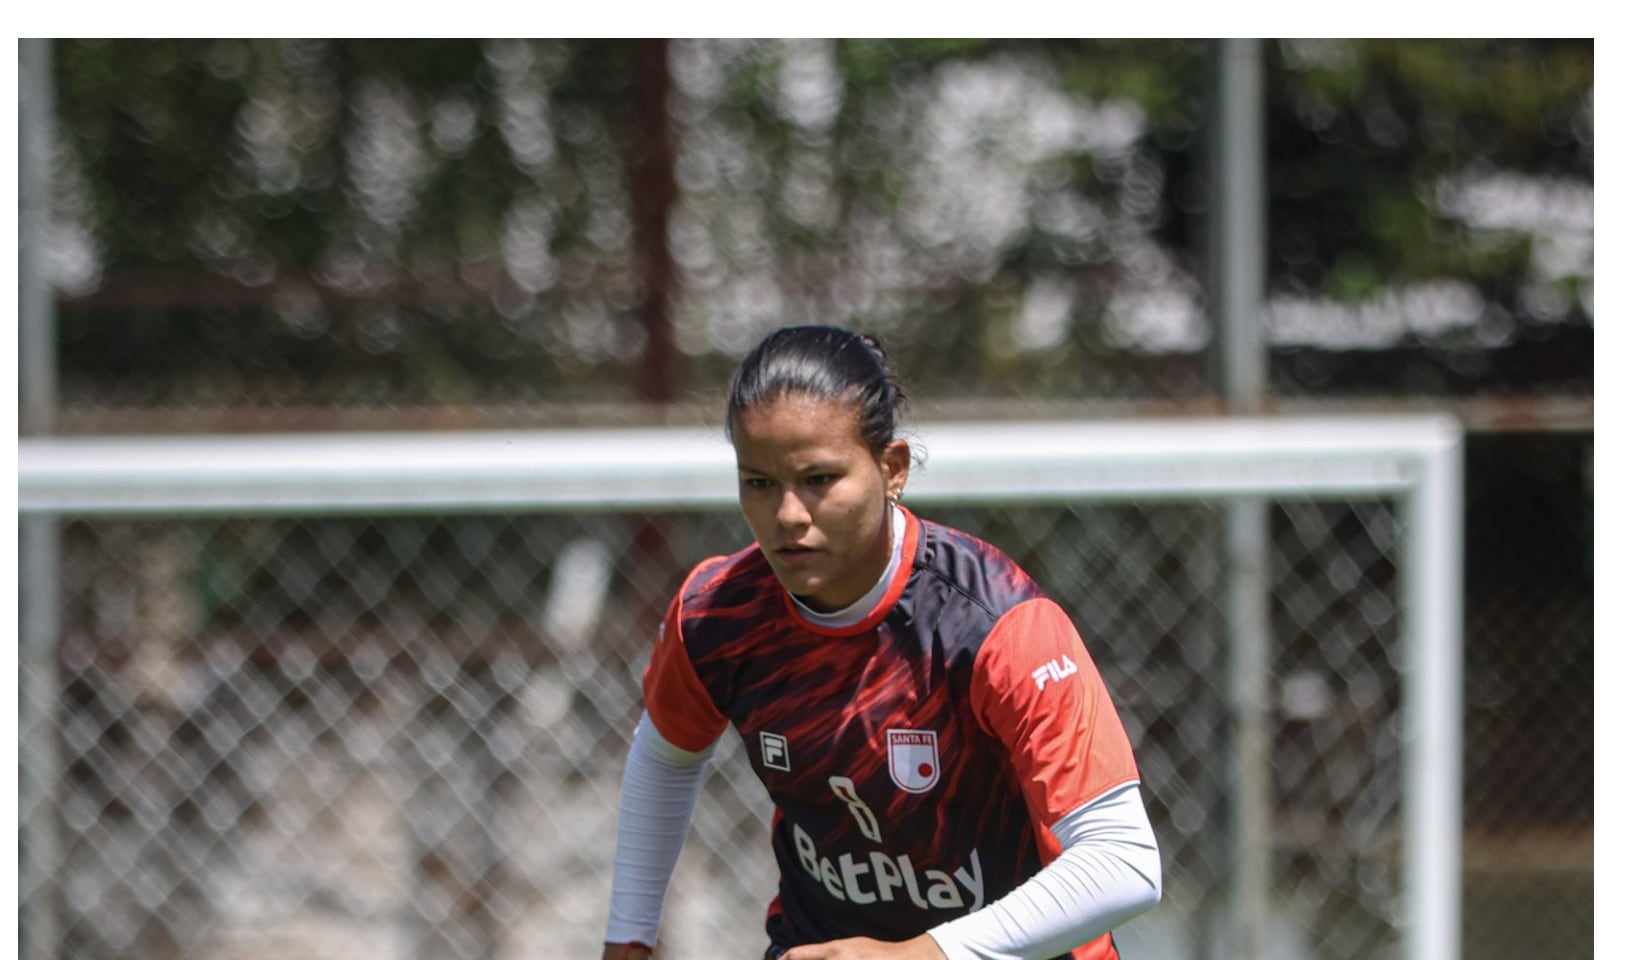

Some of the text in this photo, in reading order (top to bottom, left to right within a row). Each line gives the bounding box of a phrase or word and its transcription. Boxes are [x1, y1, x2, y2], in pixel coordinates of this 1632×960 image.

[1032, 654, 1078, 691] FILA
[891, 734, 933, 745] SANTA FE
[829, 775, 882, 843] 8
[793, 823, 985, 914] BetPlay
